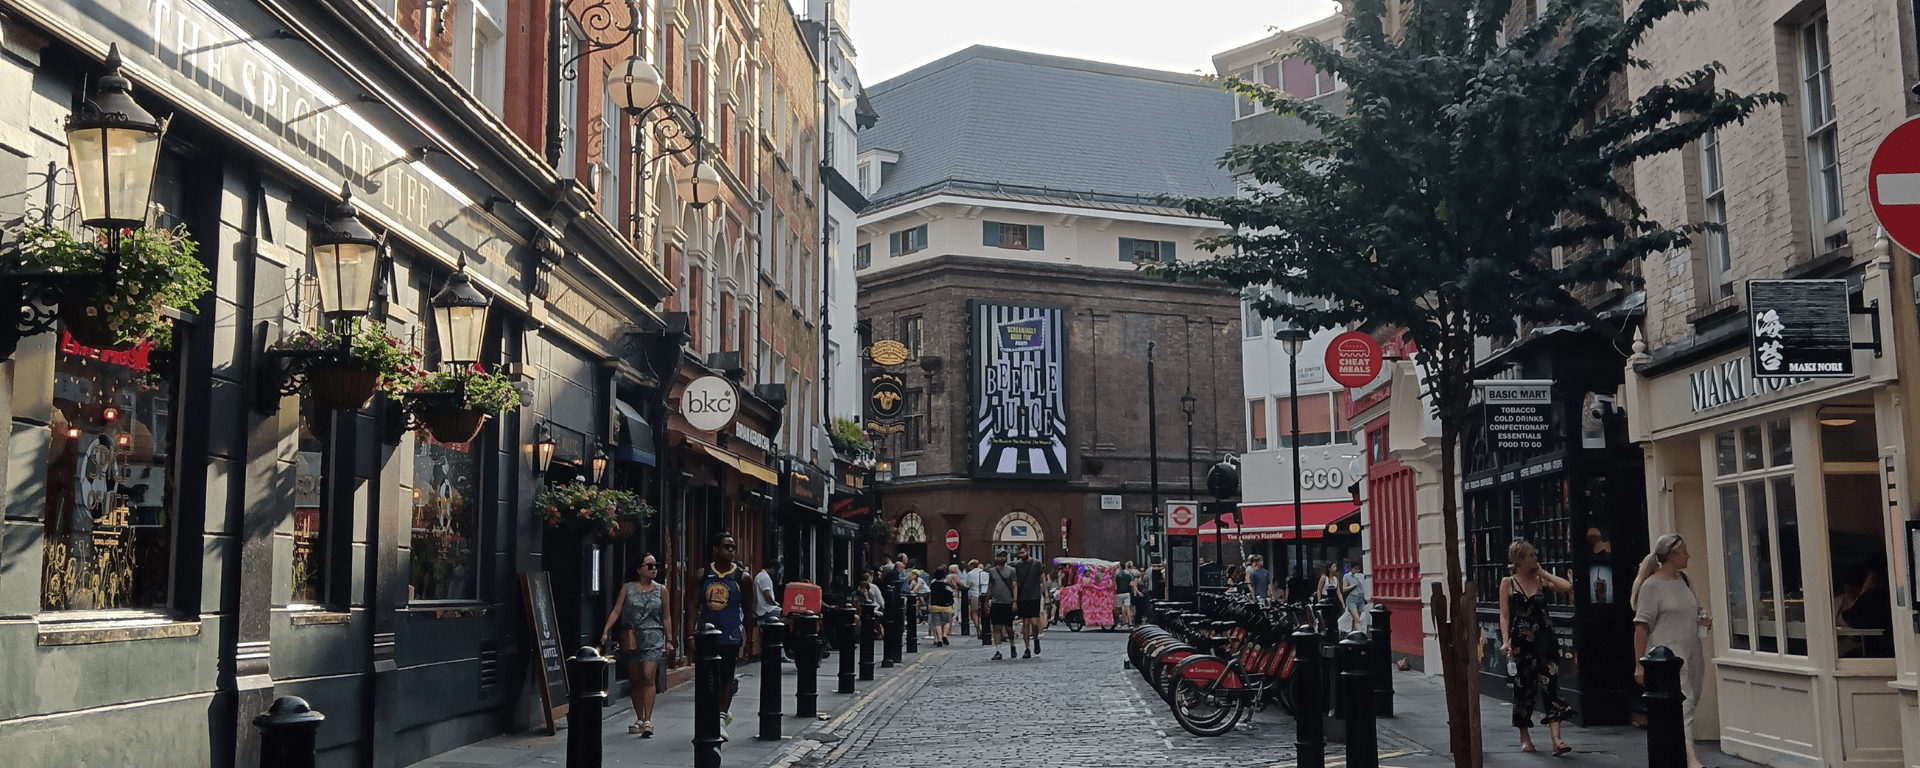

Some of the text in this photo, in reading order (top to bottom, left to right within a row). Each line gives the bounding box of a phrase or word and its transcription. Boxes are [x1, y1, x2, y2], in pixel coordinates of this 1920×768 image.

[149, 0, 431, 233] THE SPICE OF LIFE
[1339, 358, 1370, 366] CHEAT
[1789, 363, 1843, 372] MAKI NORI
[987, 362, 1058, 396] BEETLE
[1689, 357, 1748, 413] MAKI
[1489, 390, 1518, 399] BASIC
[1520, 390, 1547, 398] MART
